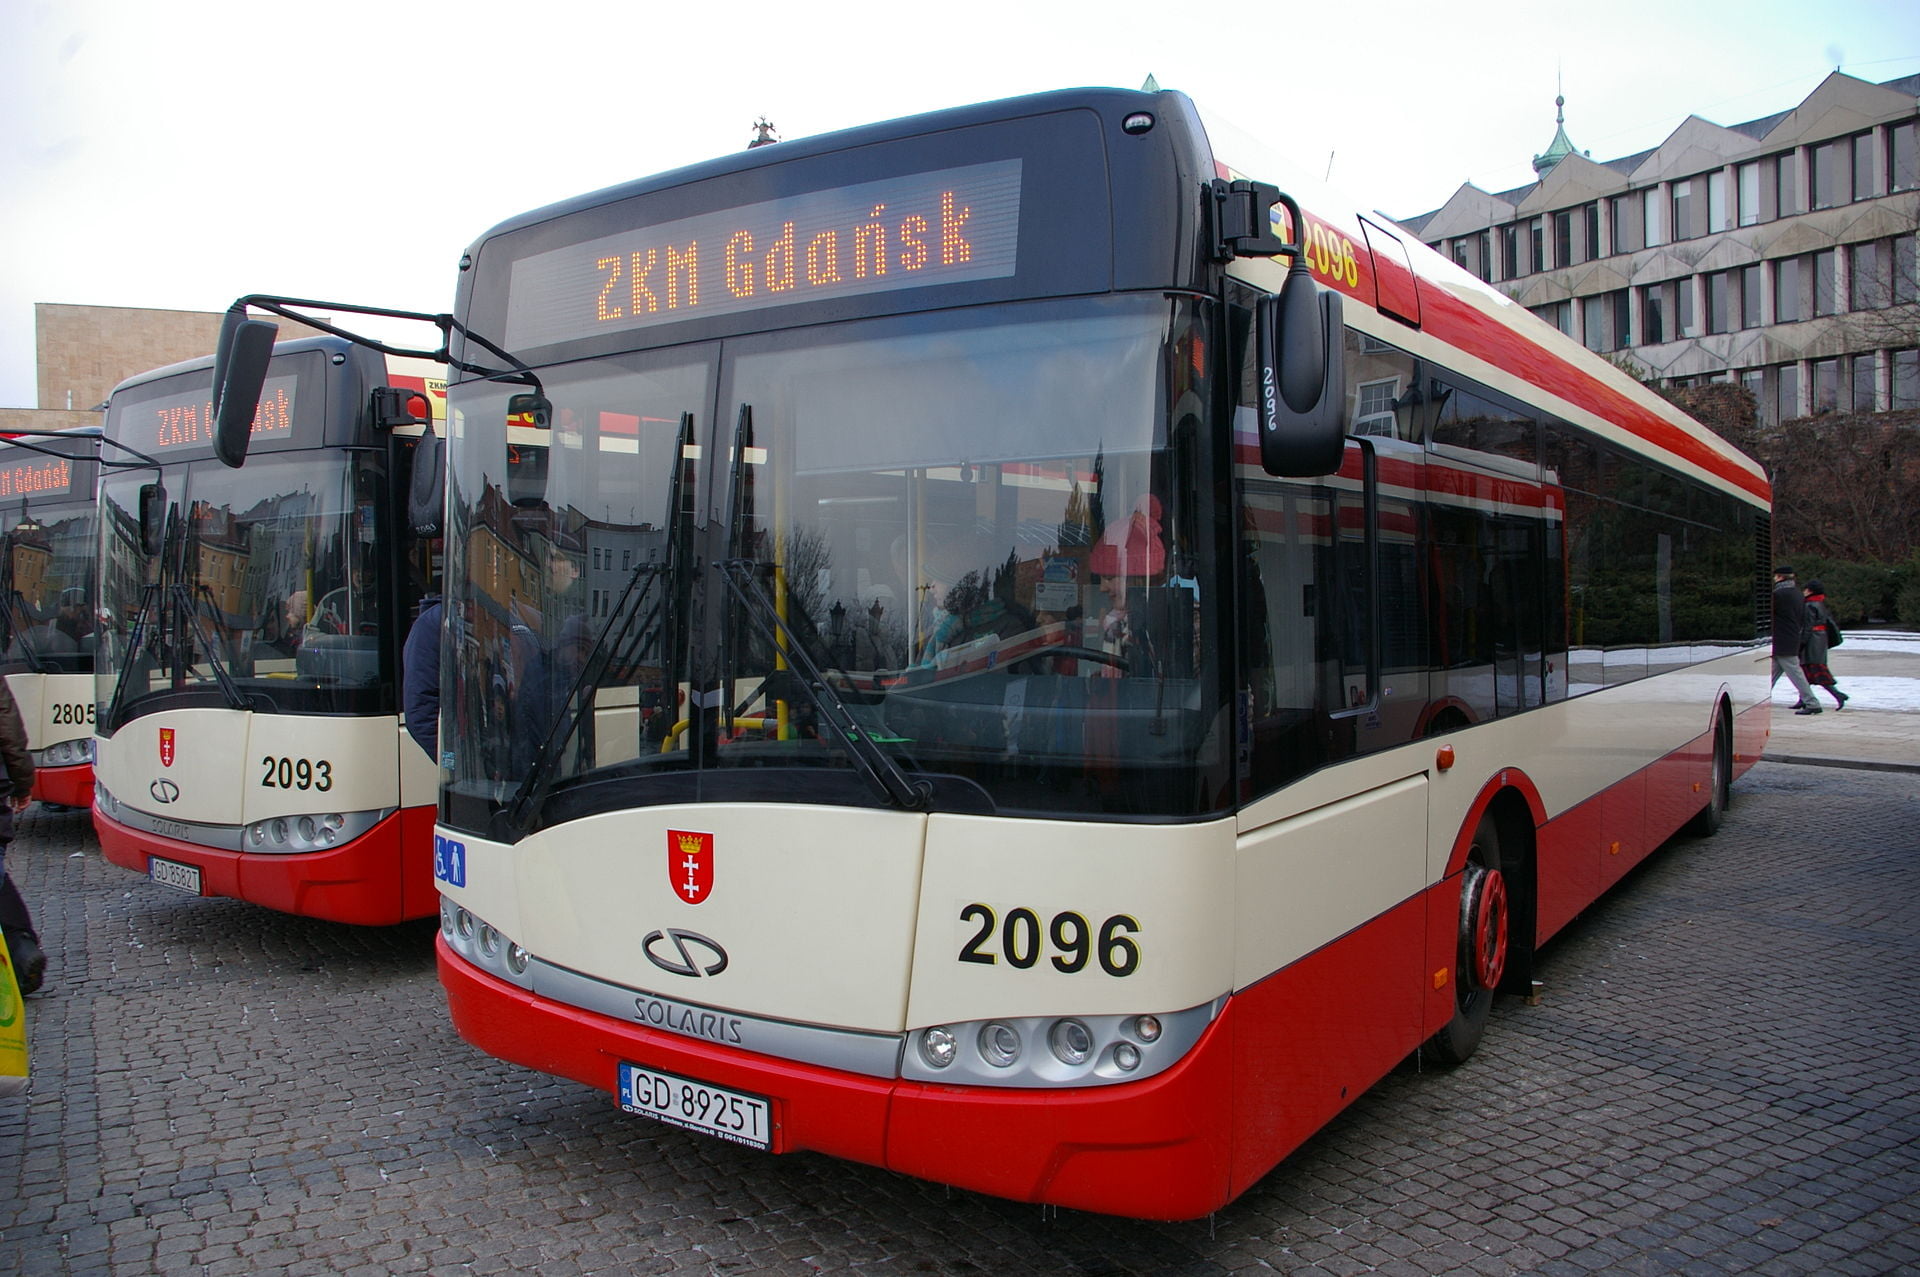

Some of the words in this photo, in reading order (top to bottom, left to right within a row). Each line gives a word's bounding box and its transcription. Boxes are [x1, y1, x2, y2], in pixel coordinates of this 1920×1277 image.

[598, 240, 697, 320] ZKM
[726, 191, 971, 297] Gdańsk
[1302, 214, 1358, 289] 2096
[1263, 366, 1277, 431] 2096
[157, 404, 197, 446] ZKM
[15, 460, 69, 493] Gdańsk
[53, 703, 95, 725] 2805
[262, 755, 332, 792] 2093
[152, 819, 190, 839] SOLARIS
[155, 861, 168, 881] GD
[957, 902, 1142, 978] 2096
[634, 998, 742, 1044] SOLARIS
[622, 1087, 632, 1099] PL
[636, 1073, 671, 1110] GD
[681, 1085, 762, 1136] 8925T
